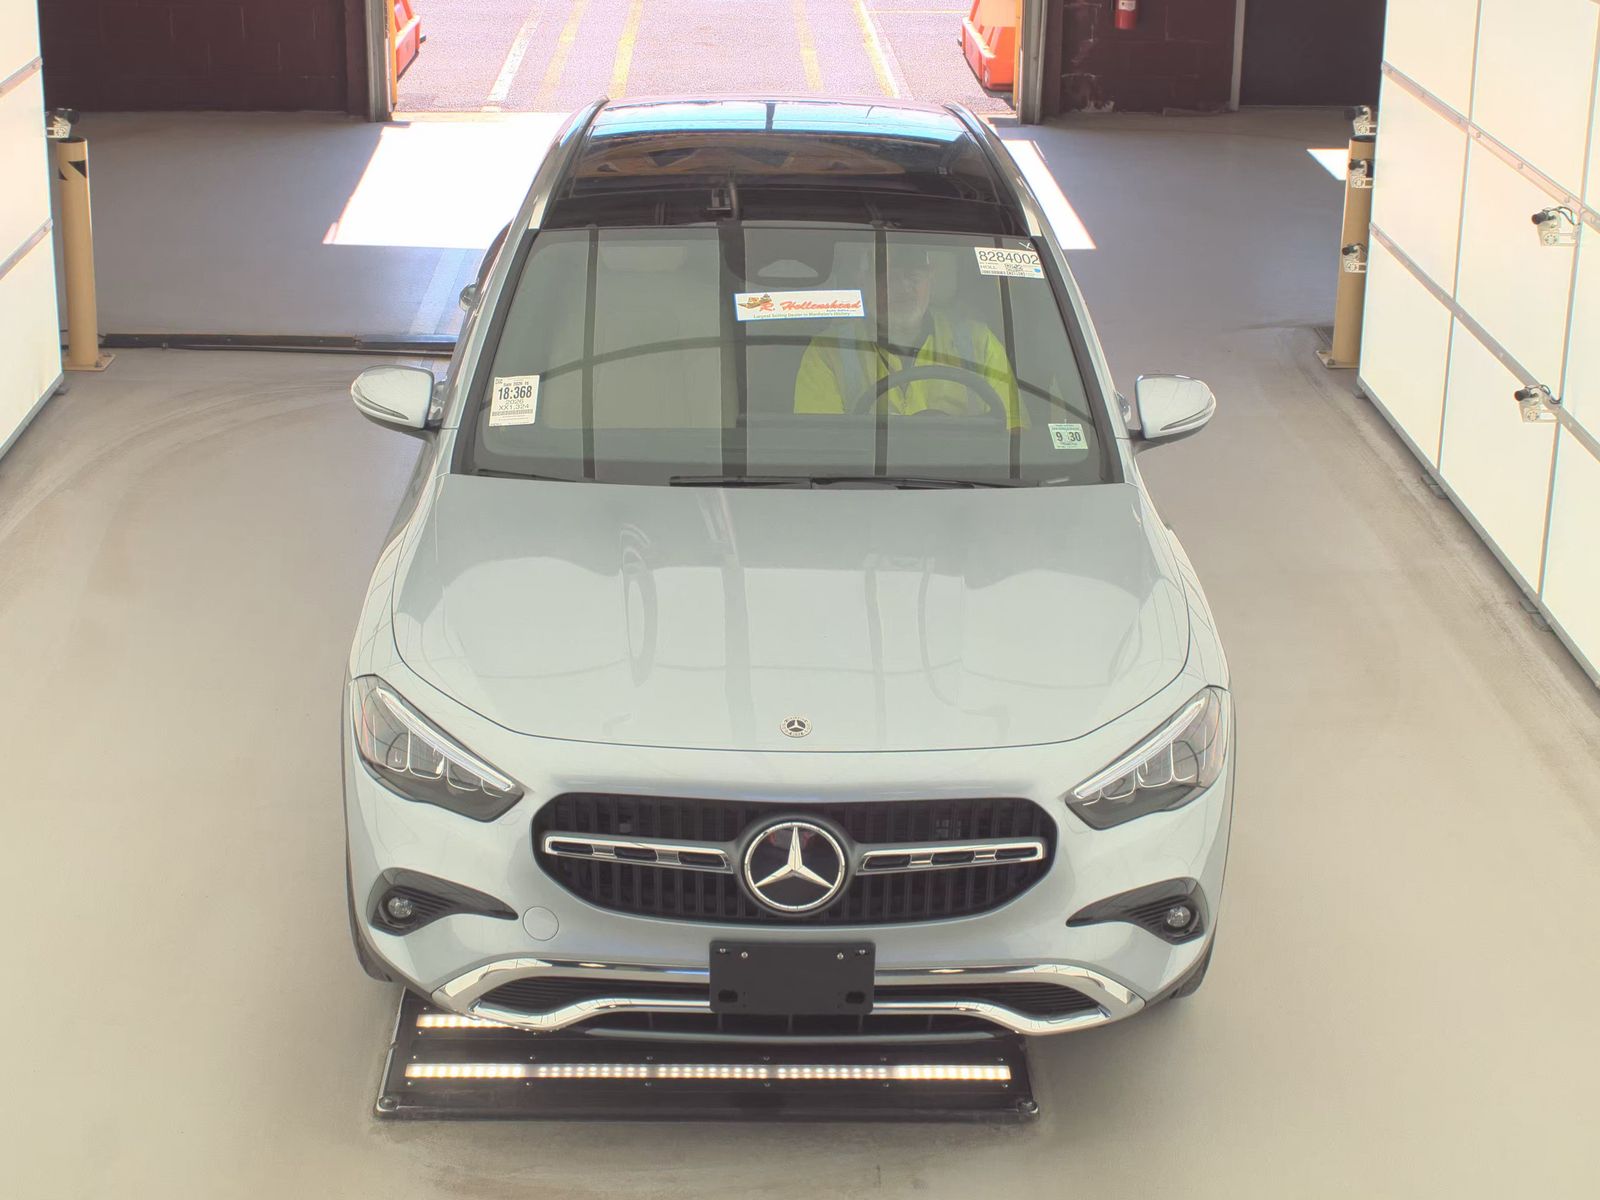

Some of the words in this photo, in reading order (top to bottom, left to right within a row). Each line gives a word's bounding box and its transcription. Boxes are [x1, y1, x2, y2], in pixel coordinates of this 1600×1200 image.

[978, 251, 1040, 265] 8284002
[780, 299, 862, 311] Hollenshead
[498, 385, 532, 400] 18:368
[1056, 431, 1063, 441] 9
[1068, 431, 1081, 441] 30
